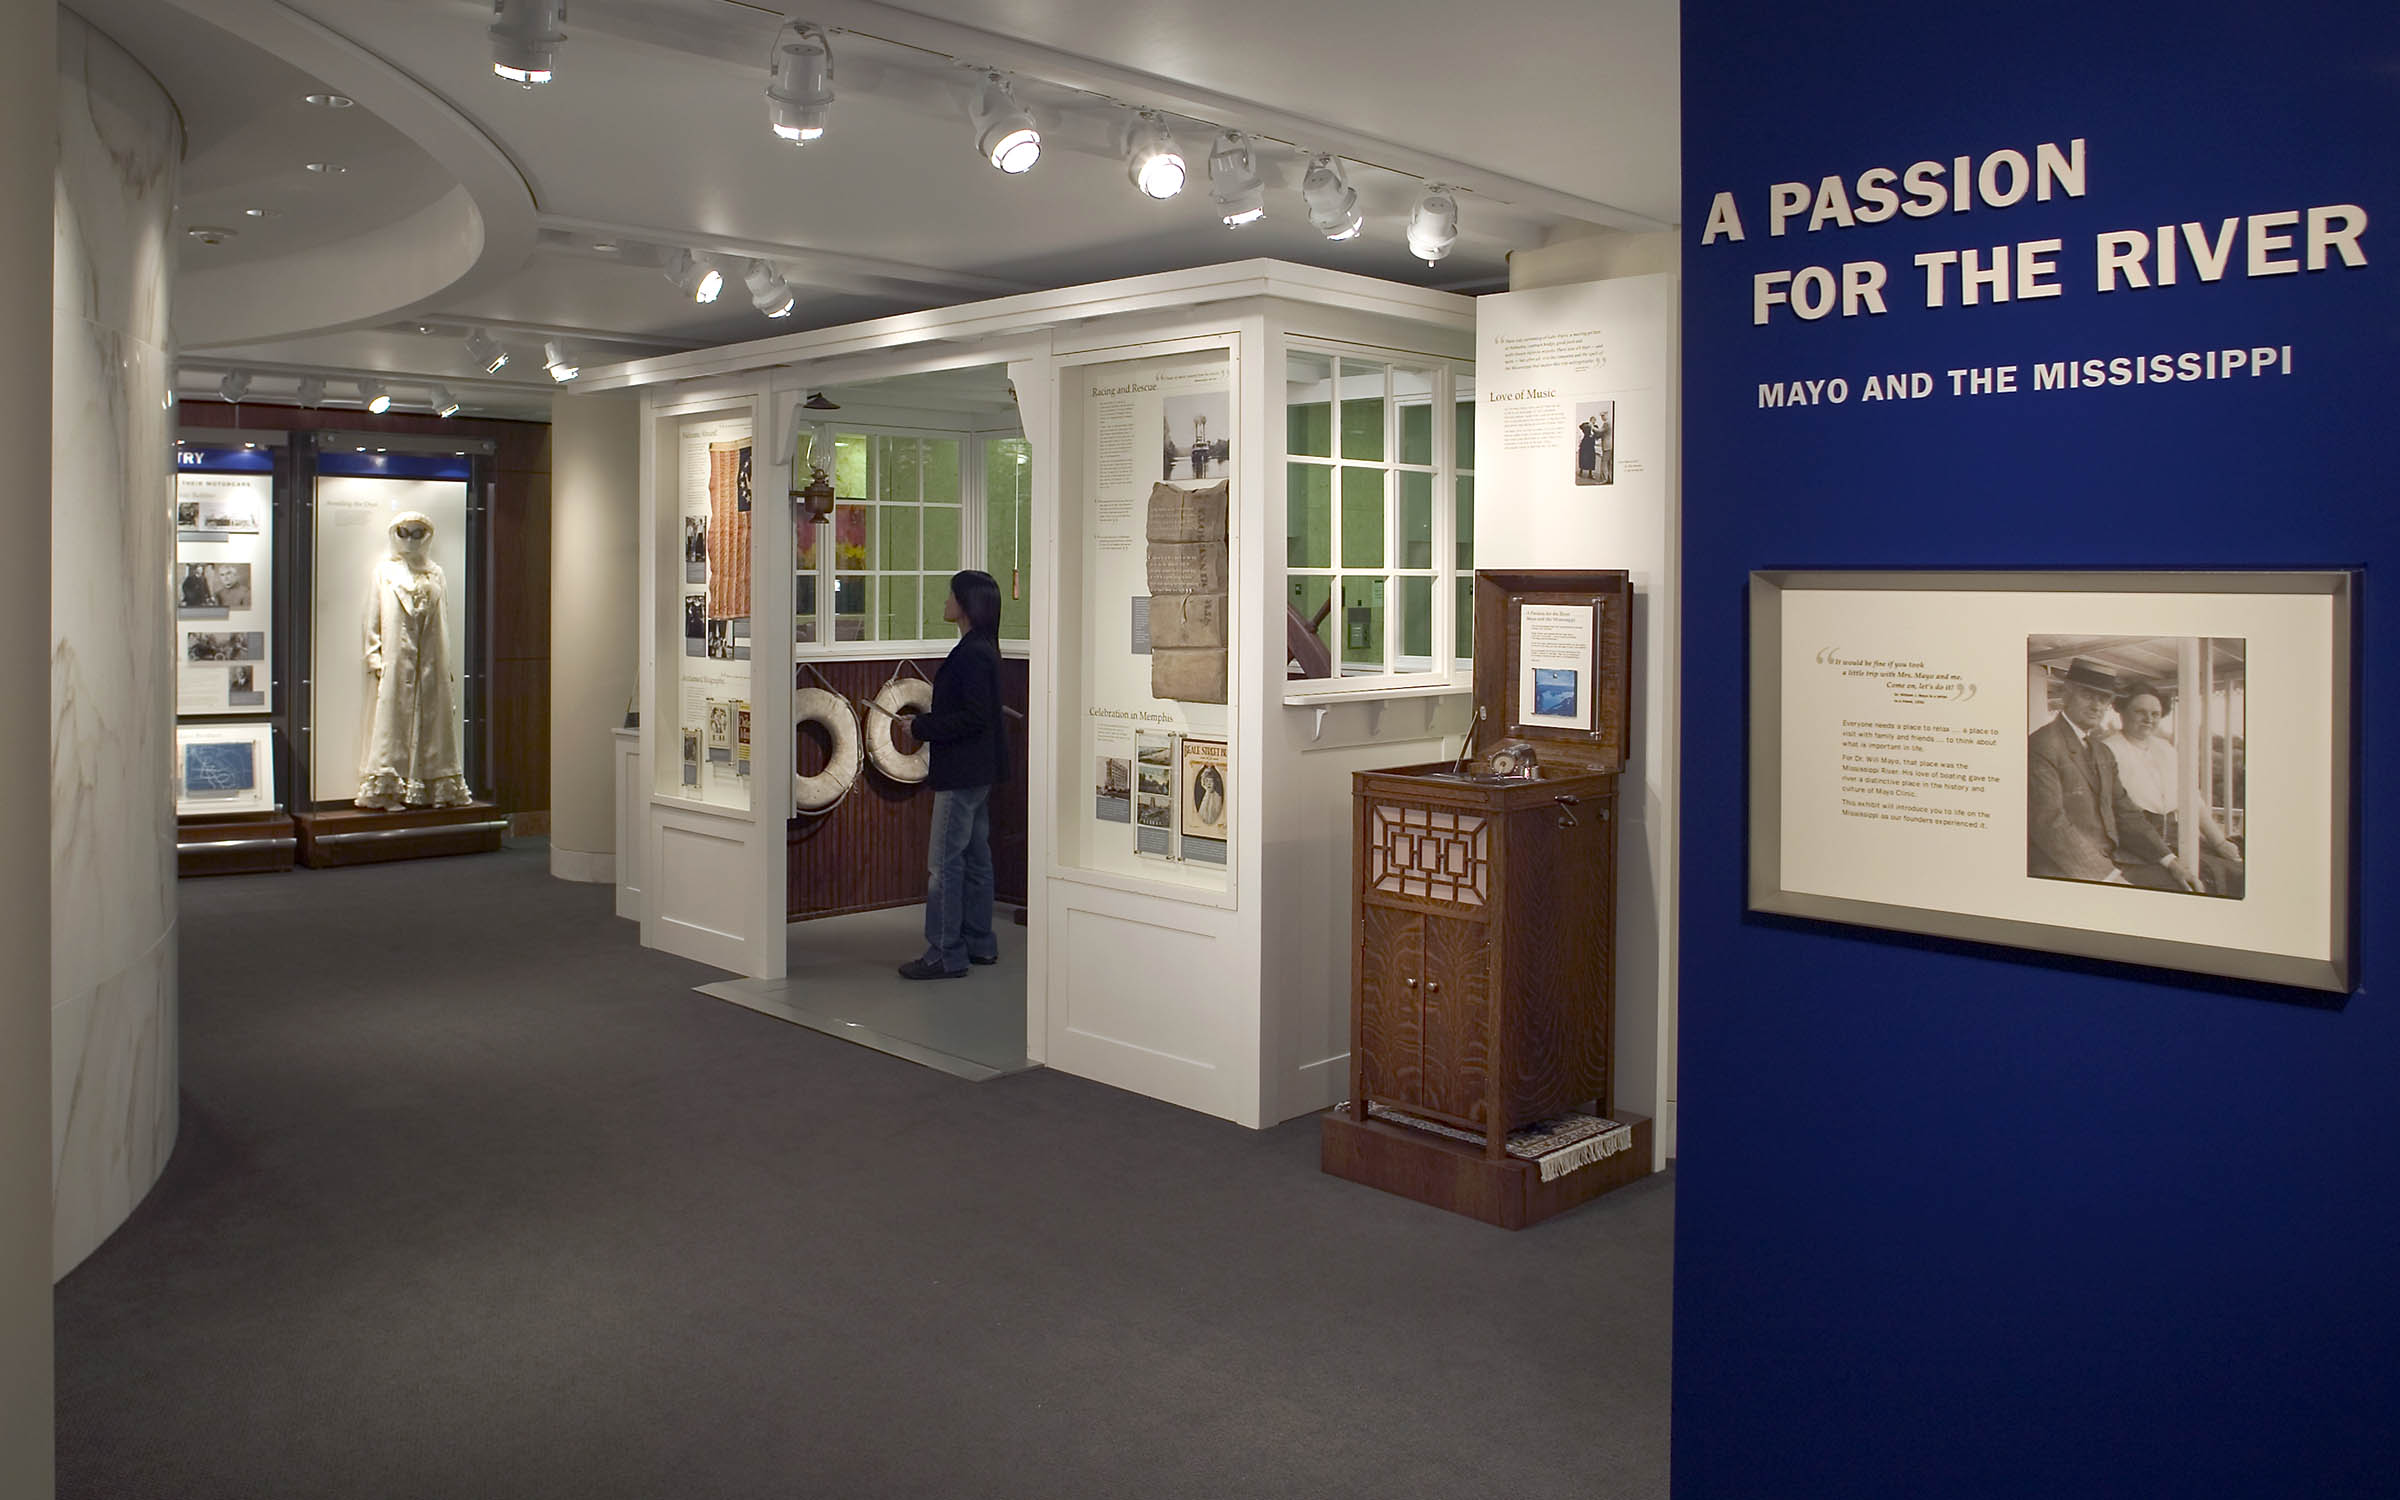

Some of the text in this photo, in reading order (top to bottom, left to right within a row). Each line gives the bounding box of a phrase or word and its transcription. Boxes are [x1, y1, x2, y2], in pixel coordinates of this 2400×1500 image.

[1702, 138, 2086, 245] A PASSION
[1754, 203, 2368, 325] FOR THE RIVER
[1758, 345, 2291, 409] MAYO AND THE MISSISSIPPI
[1092, 384, 1157, 397] Racing and Rescue
[1490, 388, 1556, 402] Love of Music
[1089, 706, 1129, 719] Celebration
[1140, 712, 1173, 724] Memphis
[1842, 720, 1873, 728] Everyone
[1903, 723, 1921, 731] place
[1875, 732, 1894, 740] family
[1919, 760, 1938, 768] place
[1842, 765, 1879, 773] Mississippi
[1940, 772, 1966, 781] boating
[1865, 776, 1900, 785] distinctive
[1902, 779, 1920, 787] place
[1944, 782, 1968, 792] history
[1876, 788, 1894, 796] Mayo
[1858, 800, 1880, 808] exhibit
[1896, 804, 1928, 813] introduce
[1842, 809, 1878, 819] Mississippi
[1904, 815, 1933, 824] founders
[1935, 817, 1977, 828] experienced
